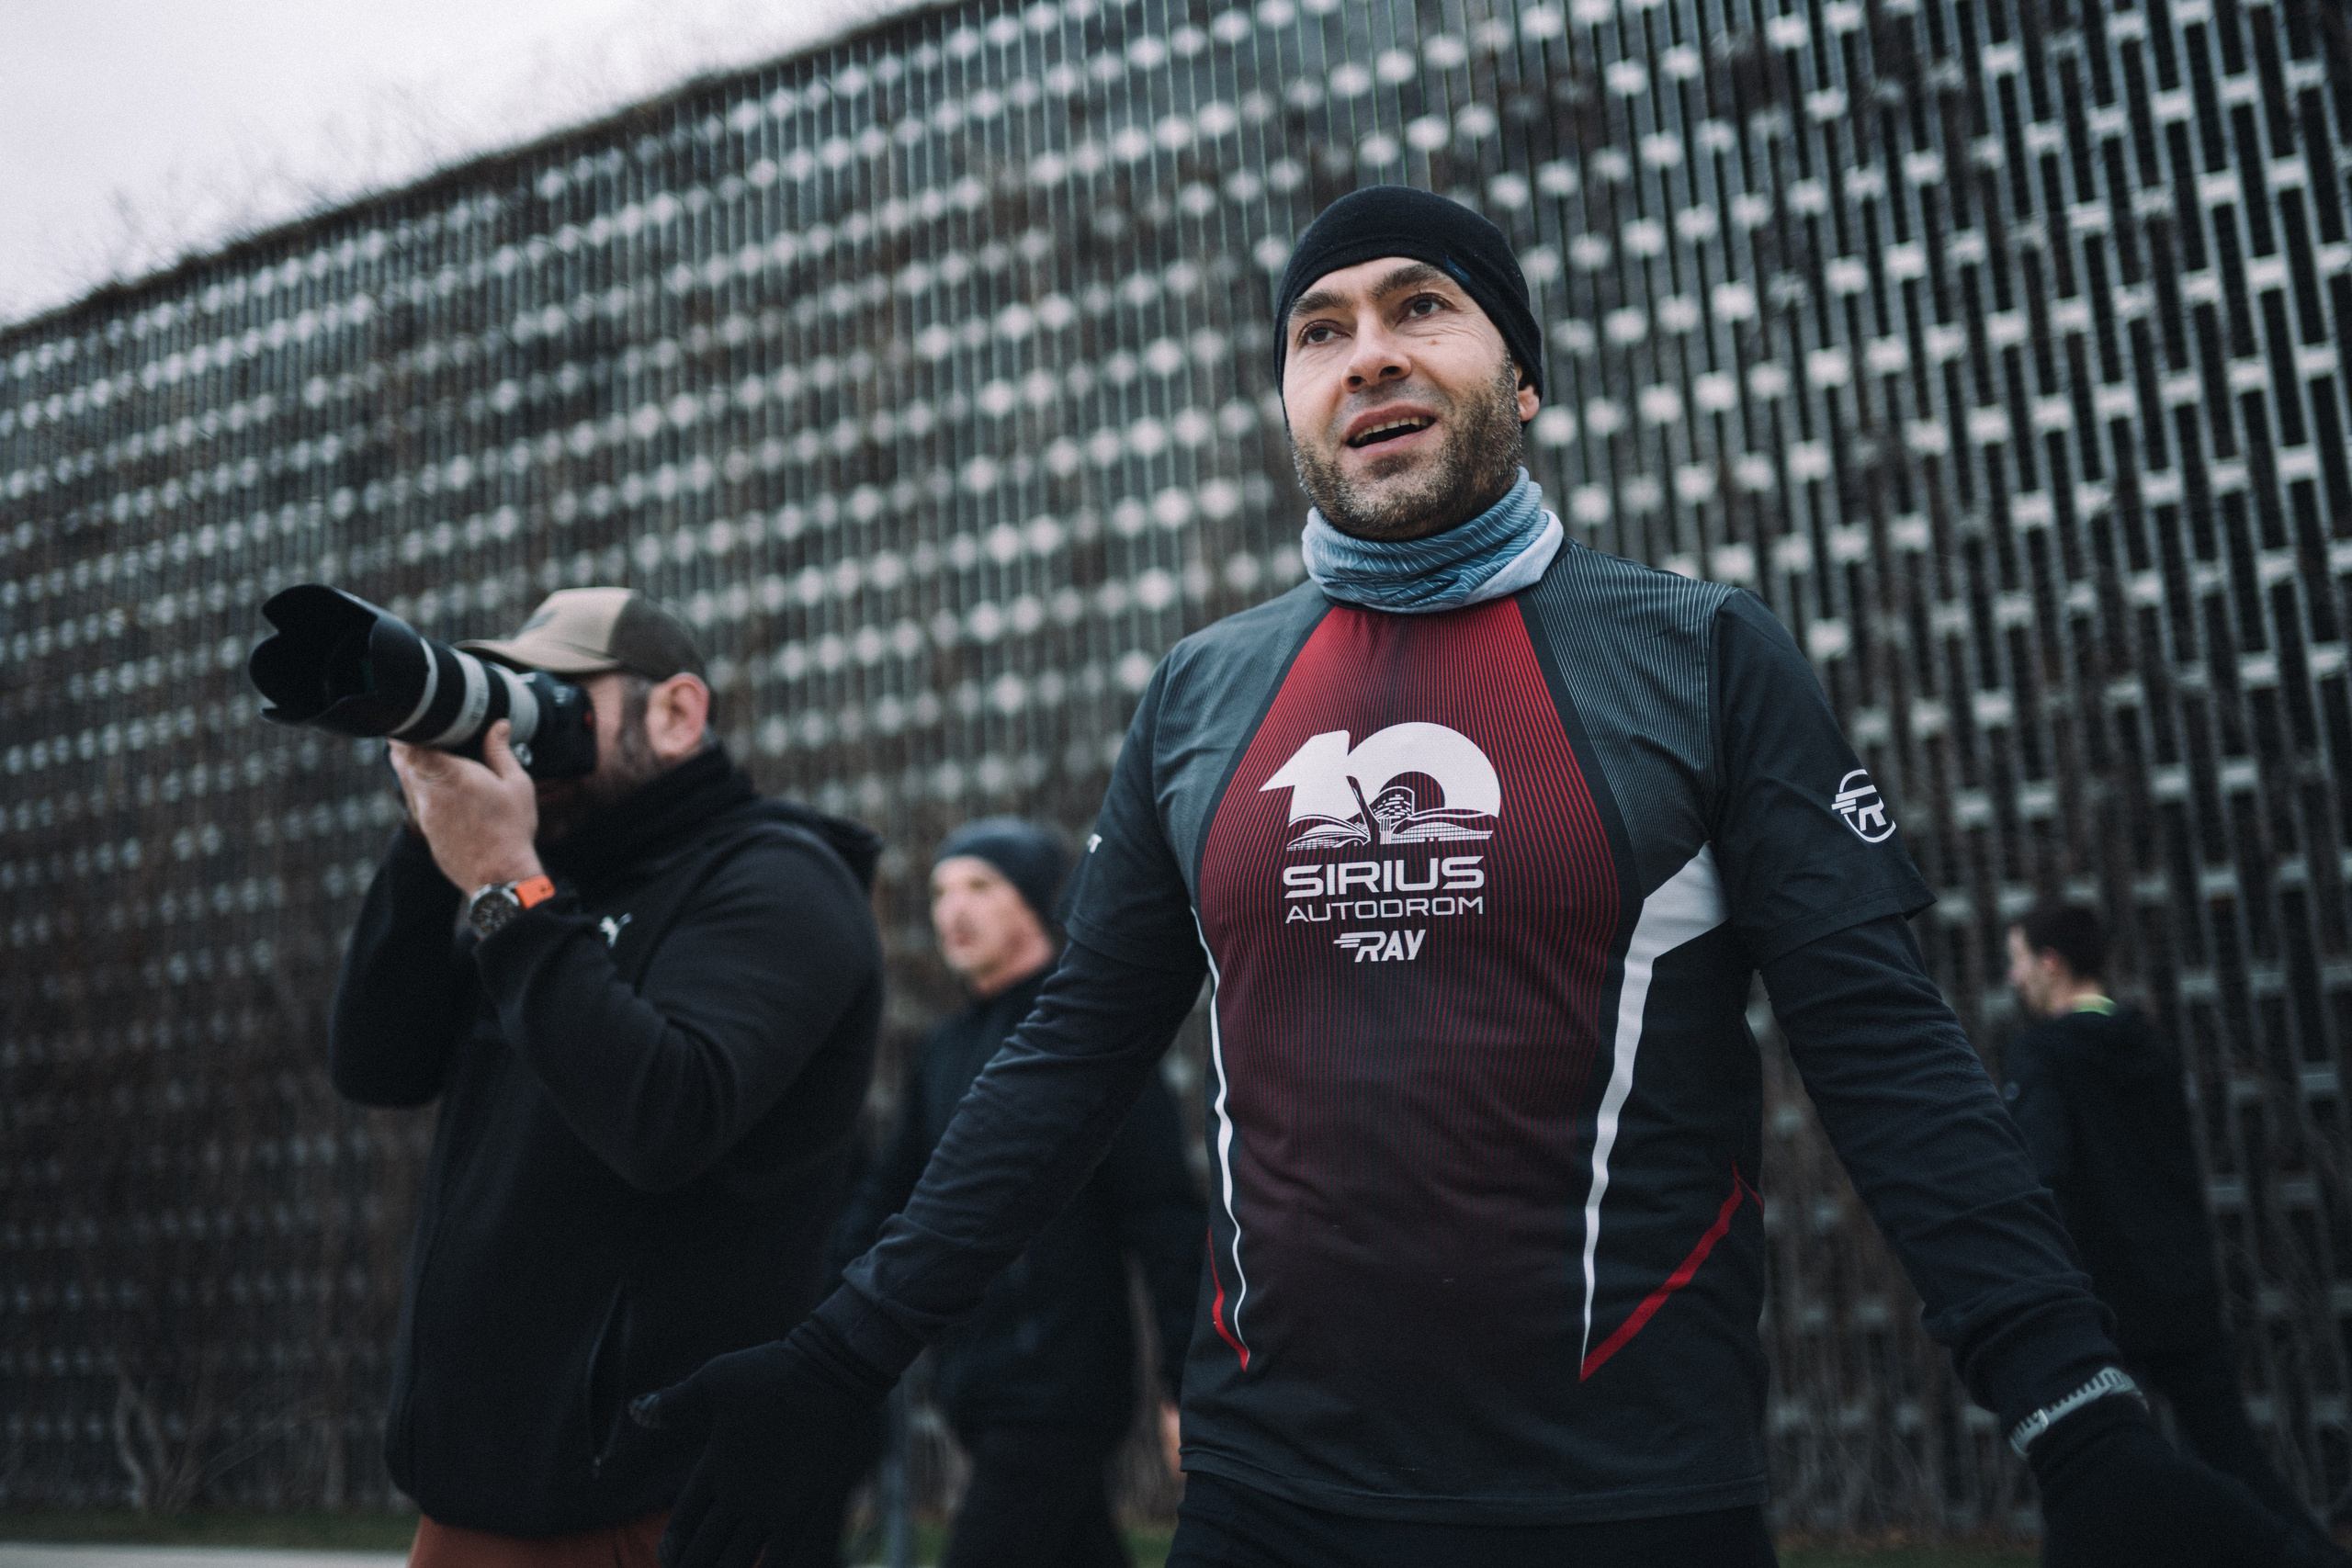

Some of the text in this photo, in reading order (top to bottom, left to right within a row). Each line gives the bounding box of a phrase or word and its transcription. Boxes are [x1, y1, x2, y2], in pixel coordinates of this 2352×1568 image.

[1259, 721, 1501, 834] 10
[1283, 855, 1485, 898] SIRIUS
[1285, 896, 1483, 923] AUTODROM
[1333, 929, 1426, 963] RAY
